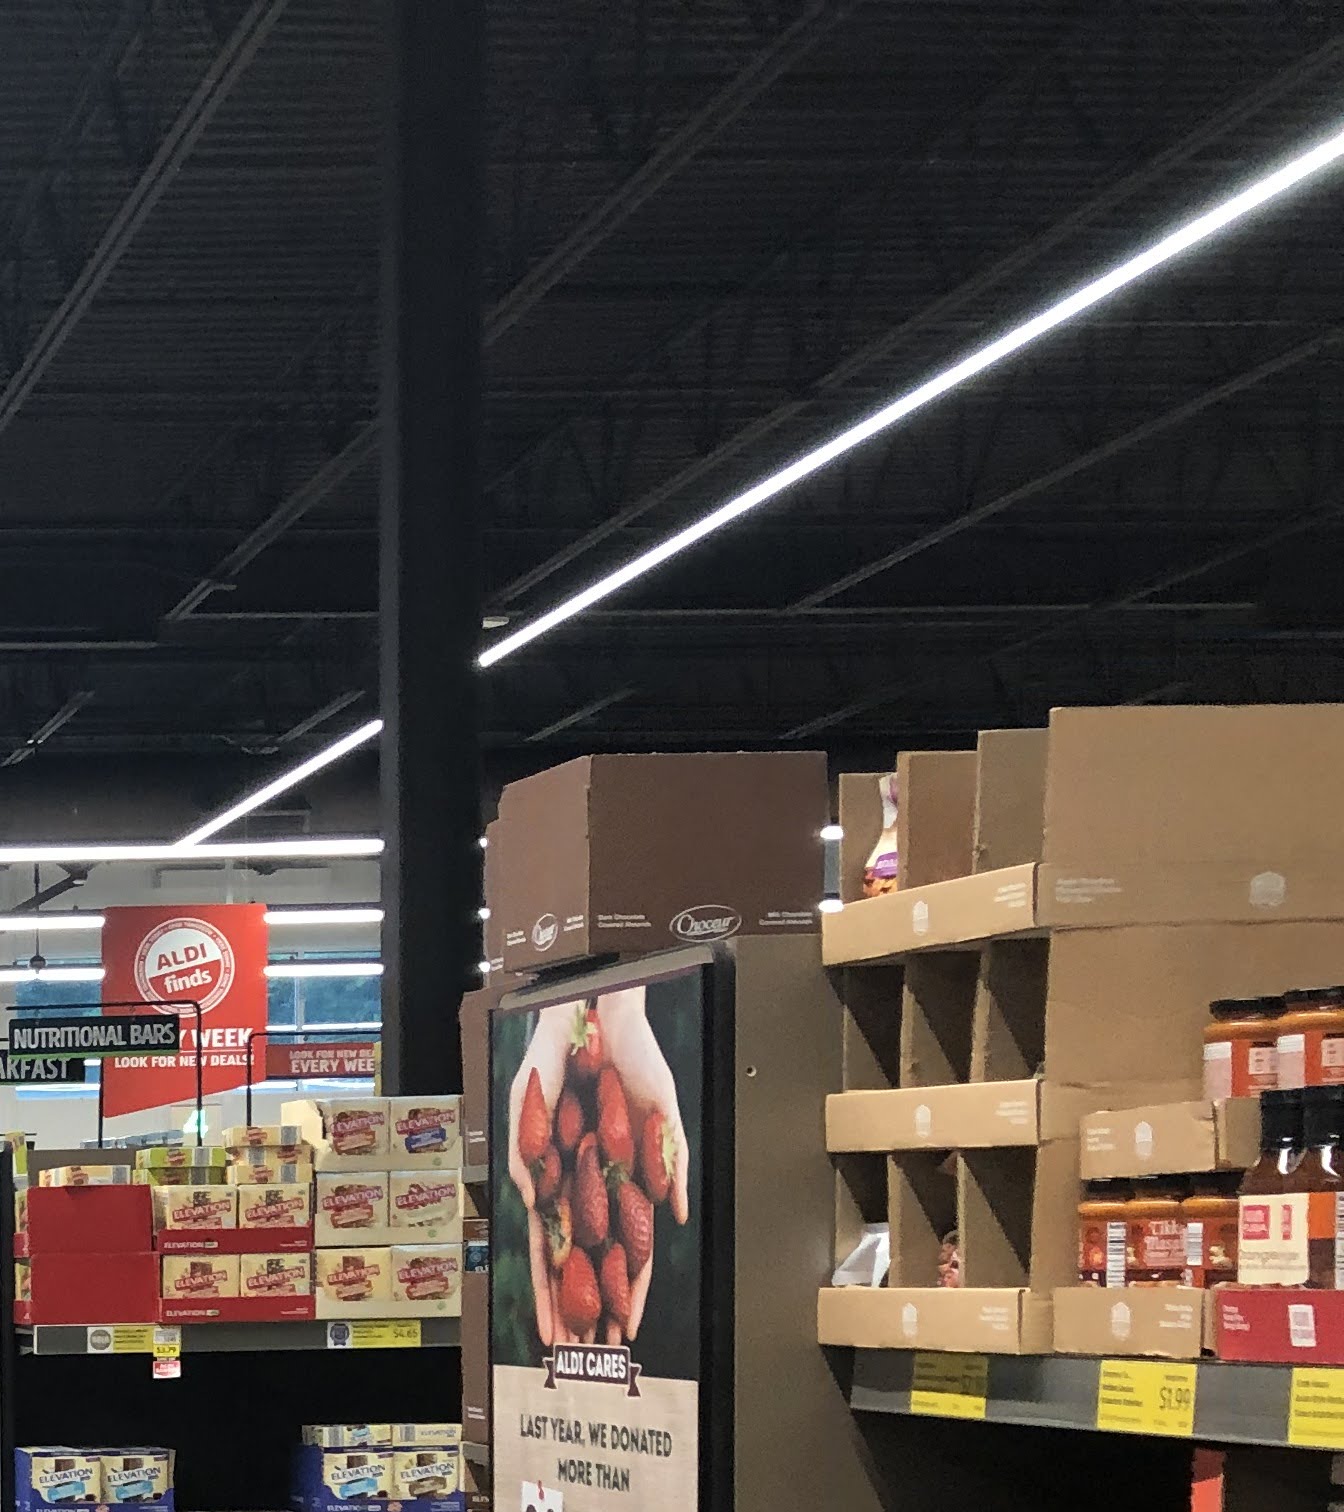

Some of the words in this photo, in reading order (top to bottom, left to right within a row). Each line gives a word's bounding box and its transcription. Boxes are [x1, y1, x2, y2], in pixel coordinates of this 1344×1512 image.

[156, 942, 208, 971] ALDI
[163, 967, 213, 994] finds
[13, 1023, 127, 1051] NUTRITIONAL
[130, 1022, 176, 1046] BARS
[114, 1057, 150, 1069] LOOK
[151, 1056, 177, 1068] FOR
[291, 1058, 340, 1074] EVERY
[344, 1057, 375, 1073] WEE
[555, 1350, 585, 1377] ALDI
[587, 1352, 627, 1380] CARES
[520, 1413, 549, 1439] LAST
[588, 1422, 607, 1450] WE
[610, 1425, 673, 1458] DONATED
[558, 1458, 592, 1487] MORE
[595, 1463, 631, 1492] THAN
